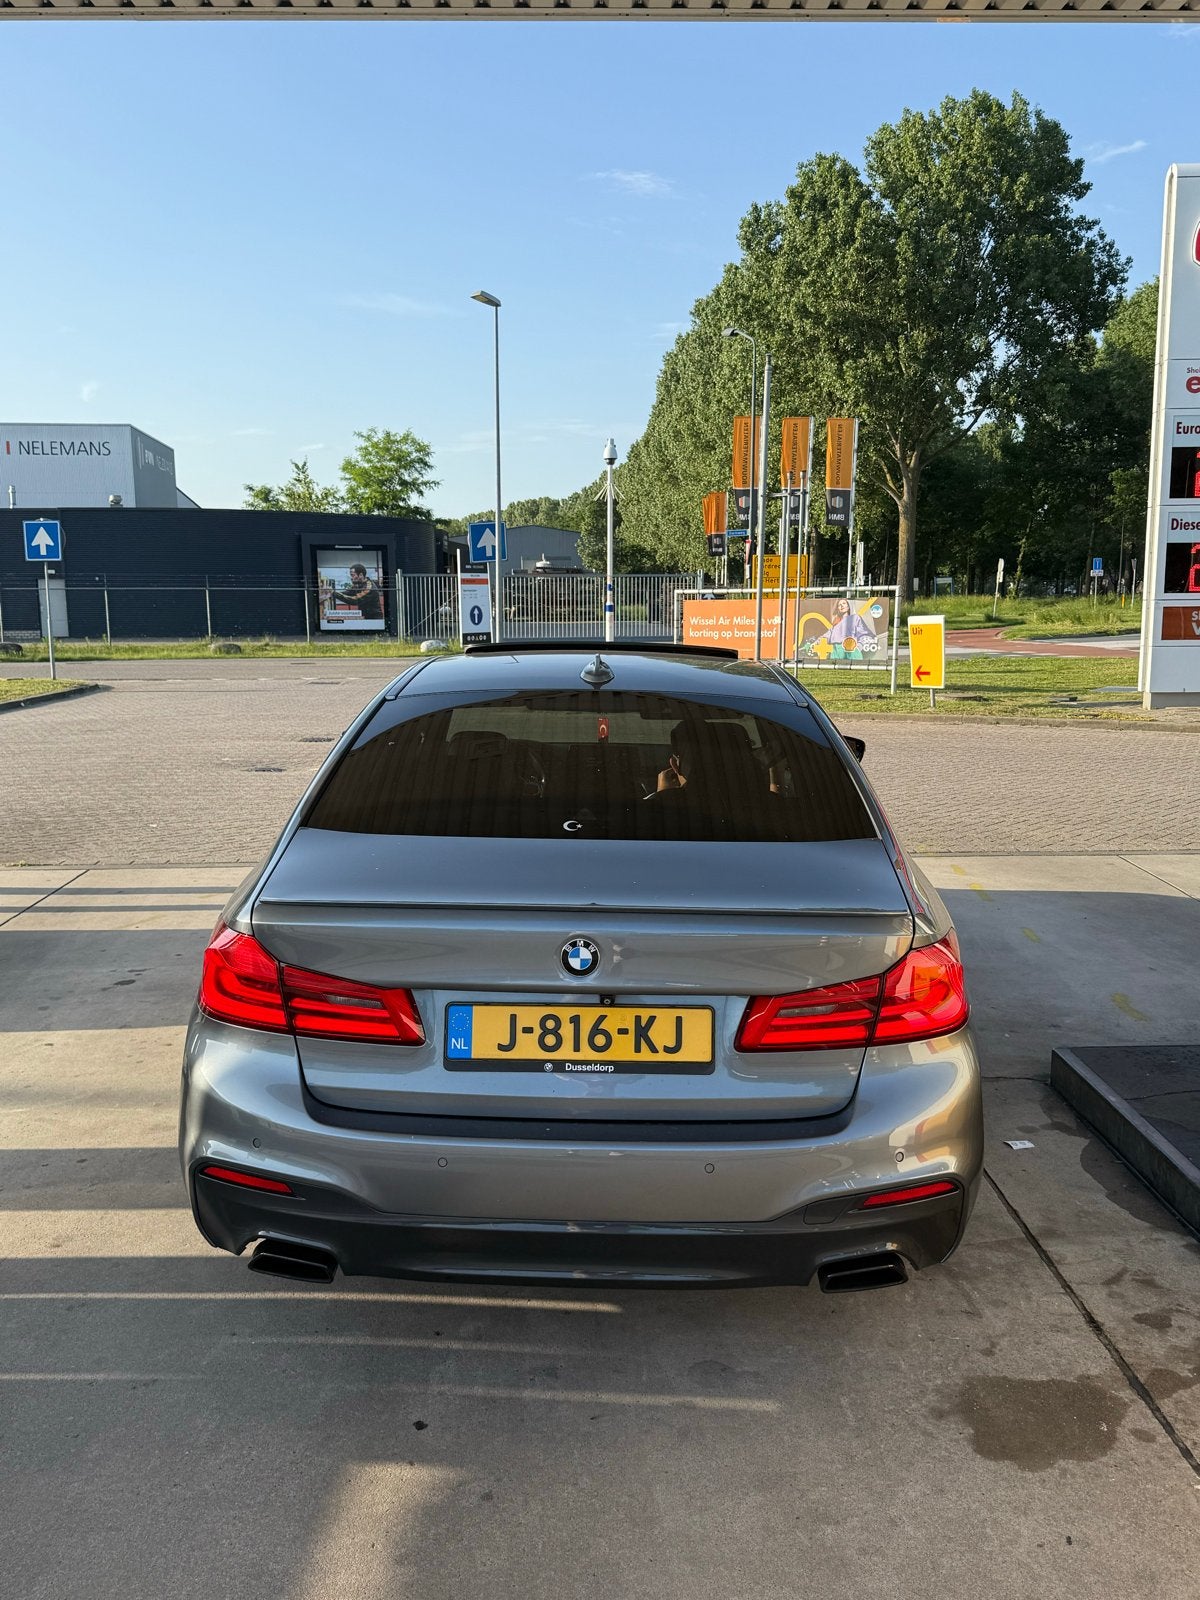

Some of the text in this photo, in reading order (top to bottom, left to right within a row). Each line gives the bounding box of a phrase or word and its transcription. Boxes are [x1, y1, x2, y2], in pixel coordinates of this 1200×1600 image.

[18, 441, 111, 456] NELEMANS
[690, 616, 716, 625] Wissel
[720, 616, 730, 625] Air
[733, 616, 755, 625] Miles
[689, 628, 719, 639] korting
[721, 630, 732, 639] op
[912, 626, 923, 635] Uit
[565, 940, 597, 952] BMW
[497, 1013, 683, 1054] J-816-KJ
[451, 1038, 468, 1050] NL
[565, 1062, 614, 1072] Dusseldorp
